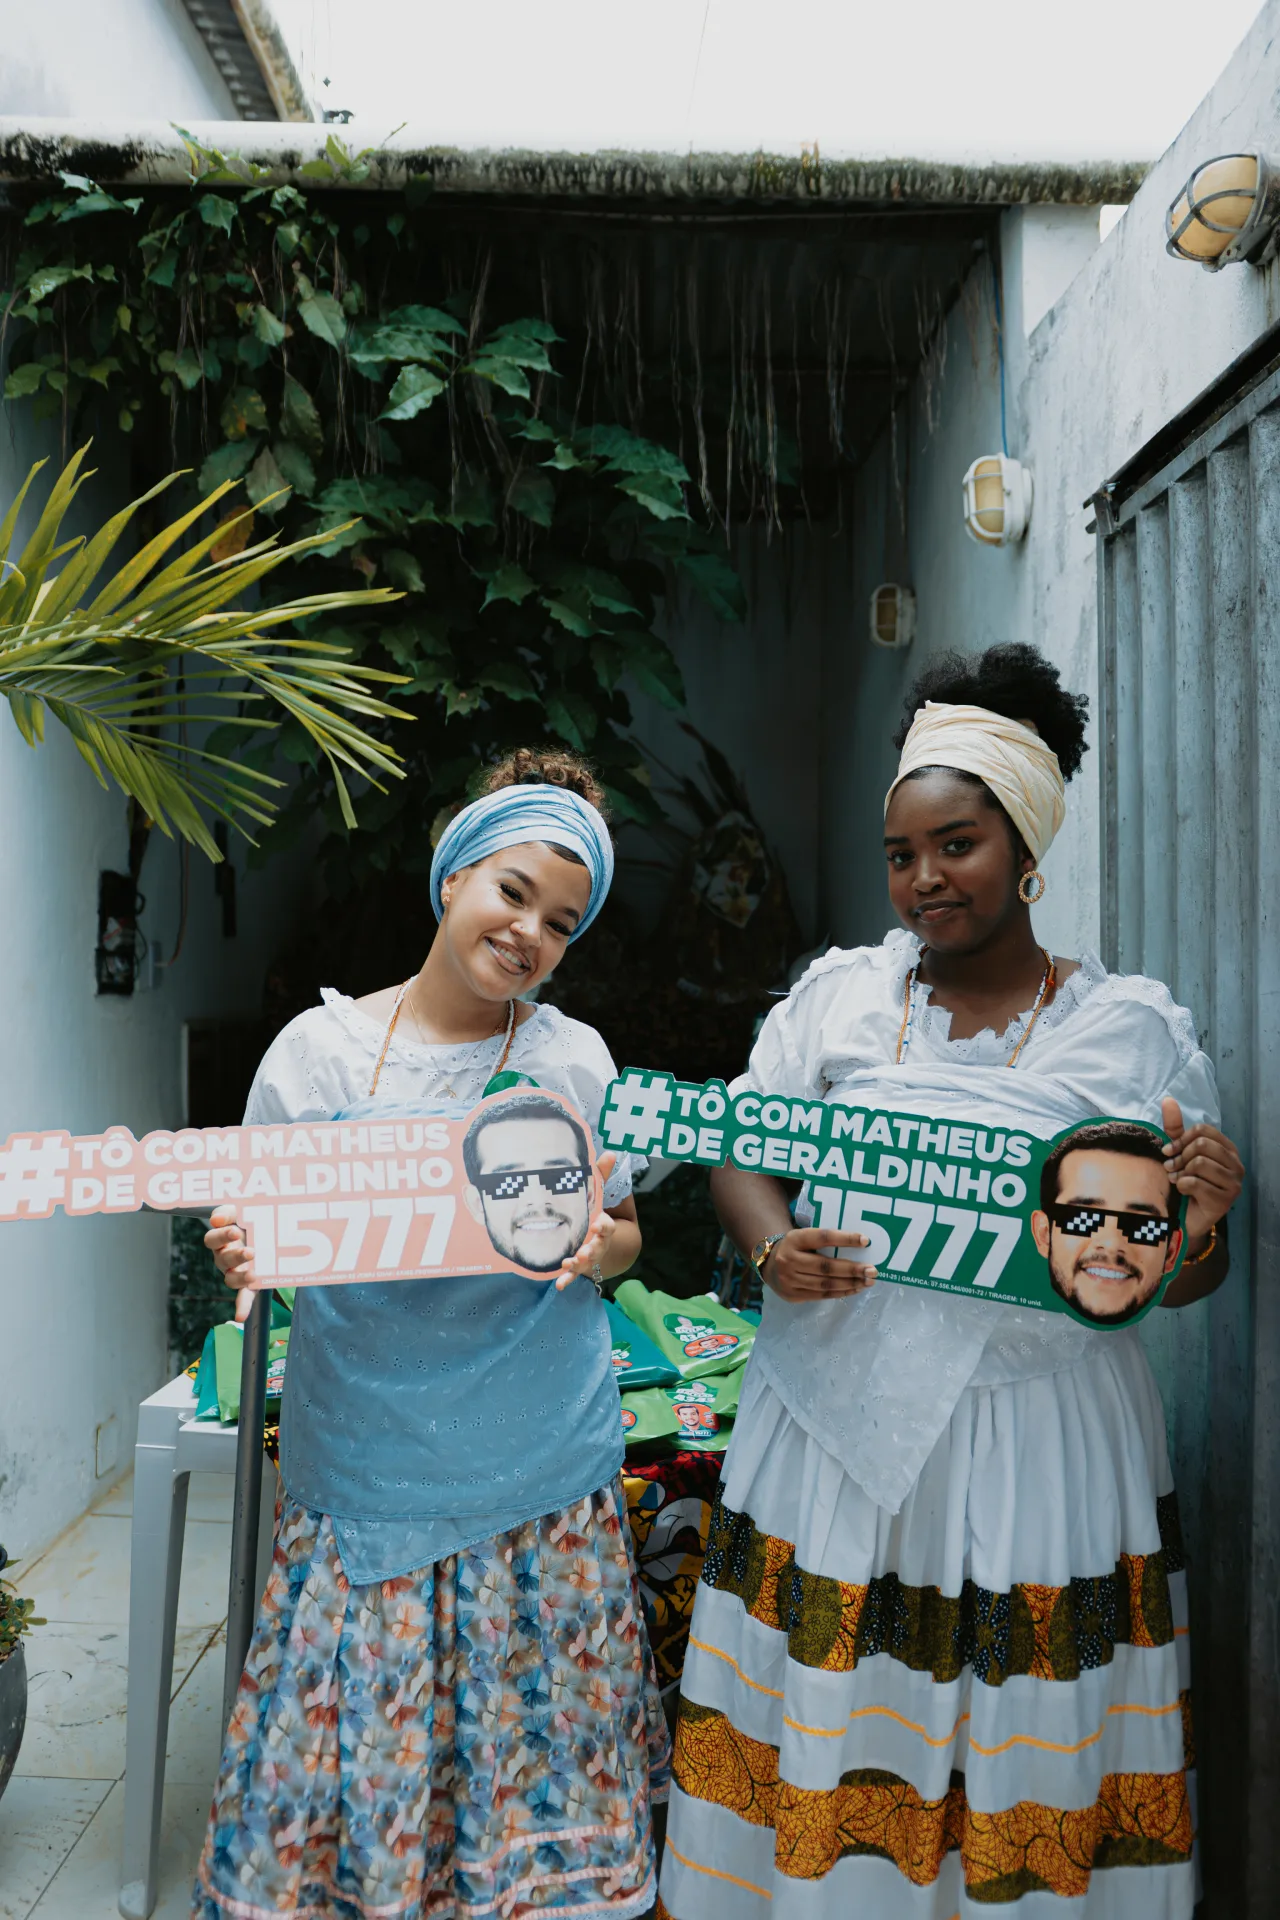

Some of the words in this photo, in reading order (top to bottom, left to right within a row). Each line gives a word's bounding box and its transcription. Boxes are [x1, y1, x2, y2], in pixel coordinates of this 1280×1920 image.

[144, 1132, 240, 1166] COM
[250, 1123, 451, 1160] MATHEUS
[667, 1122, 724, 1160] DE
[732, 1133, 1027, 1208] GERALDINHO
[735, 1096, 823, 1137] COM
[831, 1109, 1033, 1167] MATHEUS
[71, 1173, 135, 1210] DE
[147, 1156, 454, 1204] GERALDINHO
[242, 1195, 456, 1277] 15777
[813, 1184, 1023, 1289] 15777
[988, 1291, 1018, 1302] TIRAGEM:
